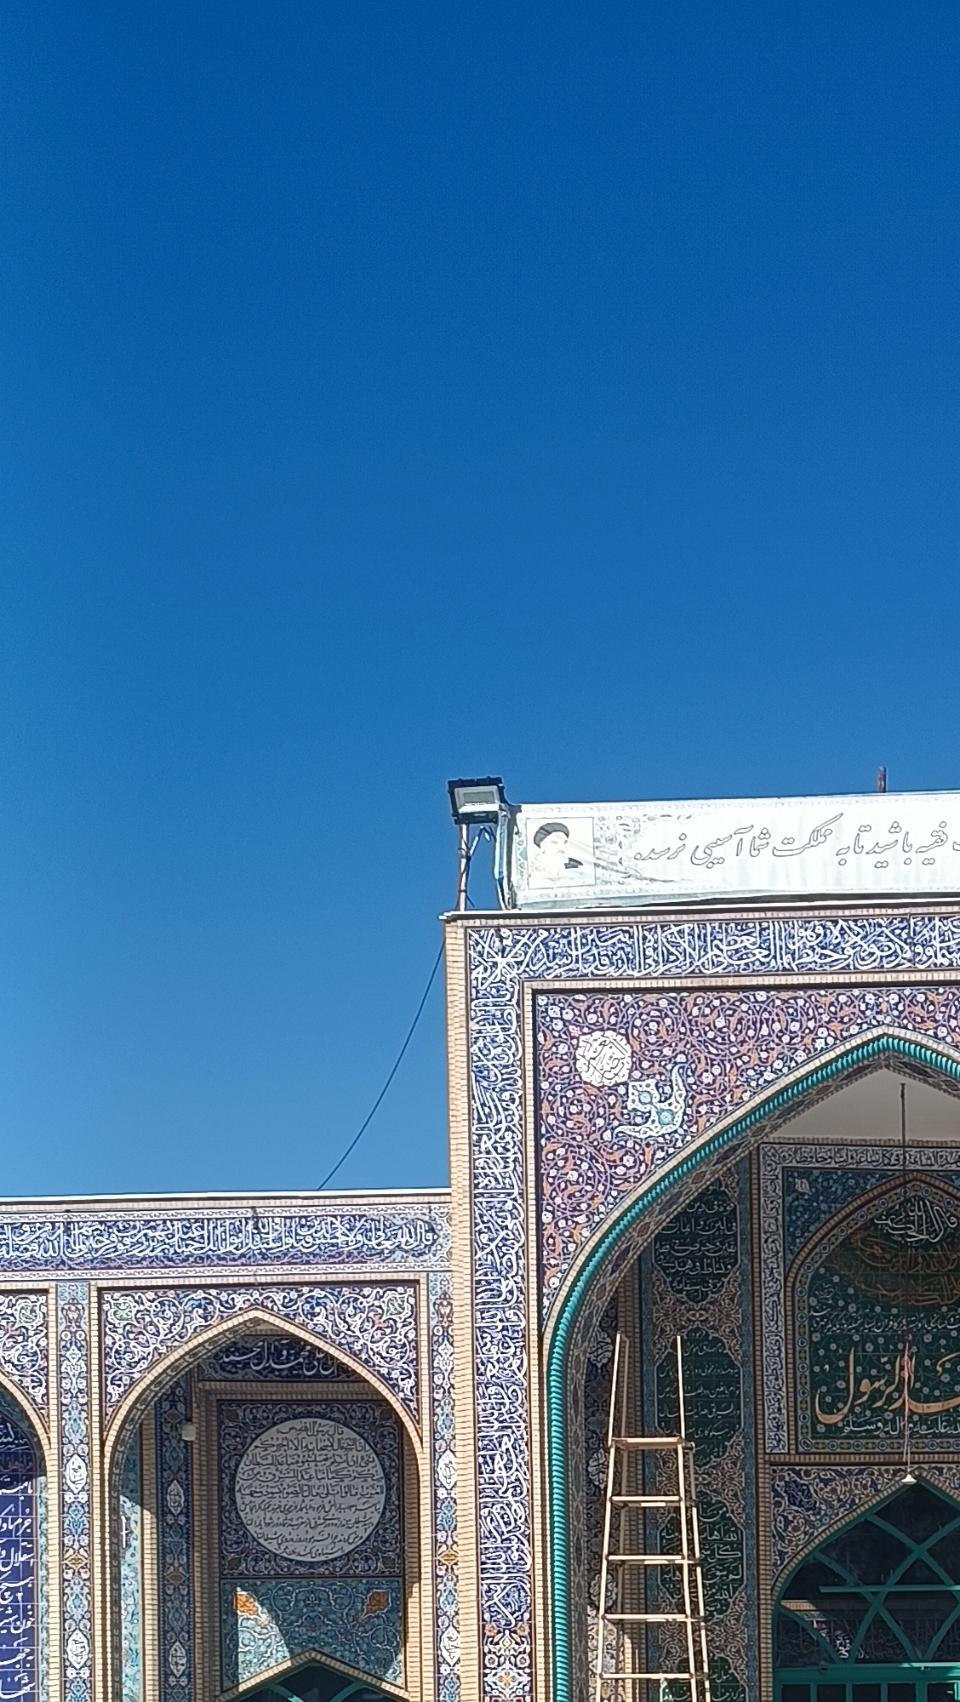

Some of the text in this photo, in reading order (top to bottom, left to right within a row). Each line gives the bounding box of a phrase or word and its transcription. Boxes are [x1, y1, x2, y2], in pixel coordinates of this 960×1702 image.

[690, 824, 754, 870] آسیبی
[749, 827, 771, 858] شما
[772, 812, 844, 858] مملکت
[836, 846, 851, 867] به
[853, 824, 872, 855] تا
[866, 820, 913, 869] باشید
[915, 820, 948, 866] فقیه
[815, 1346, 916, 1425] الرسول
